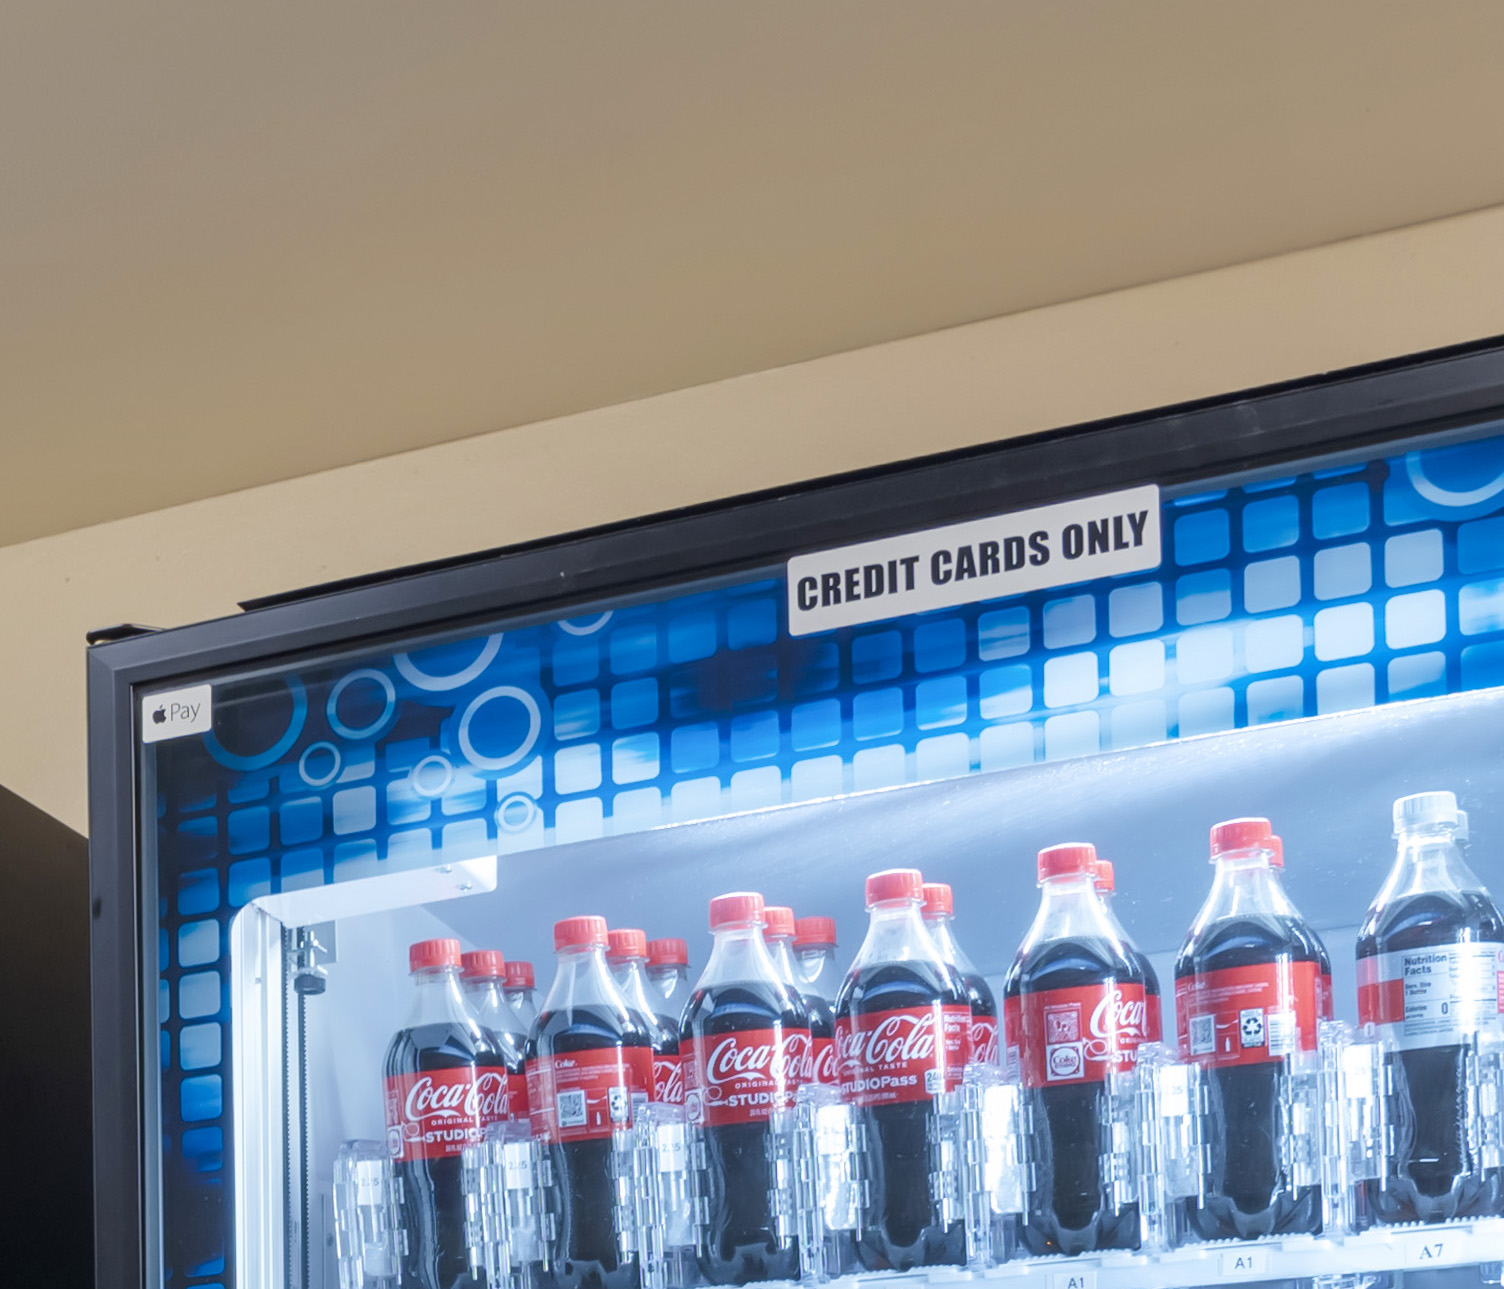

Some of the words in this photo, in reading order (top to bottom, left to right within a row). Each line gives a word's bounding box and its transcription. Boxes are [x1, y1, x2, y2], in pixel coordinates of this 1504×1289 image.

[796, 554, 920, 611] CREDIT
[930, 530, 1050, 586] CARDS
[1062, 510, 1149, 560] ONLY
[170, 702, 201, 724] Pay
[1404, 954, 1448, 966] Nutrition
[1404, 966, 1432, 976] Facts
[1419, 1244, 1445, 1259] A7
